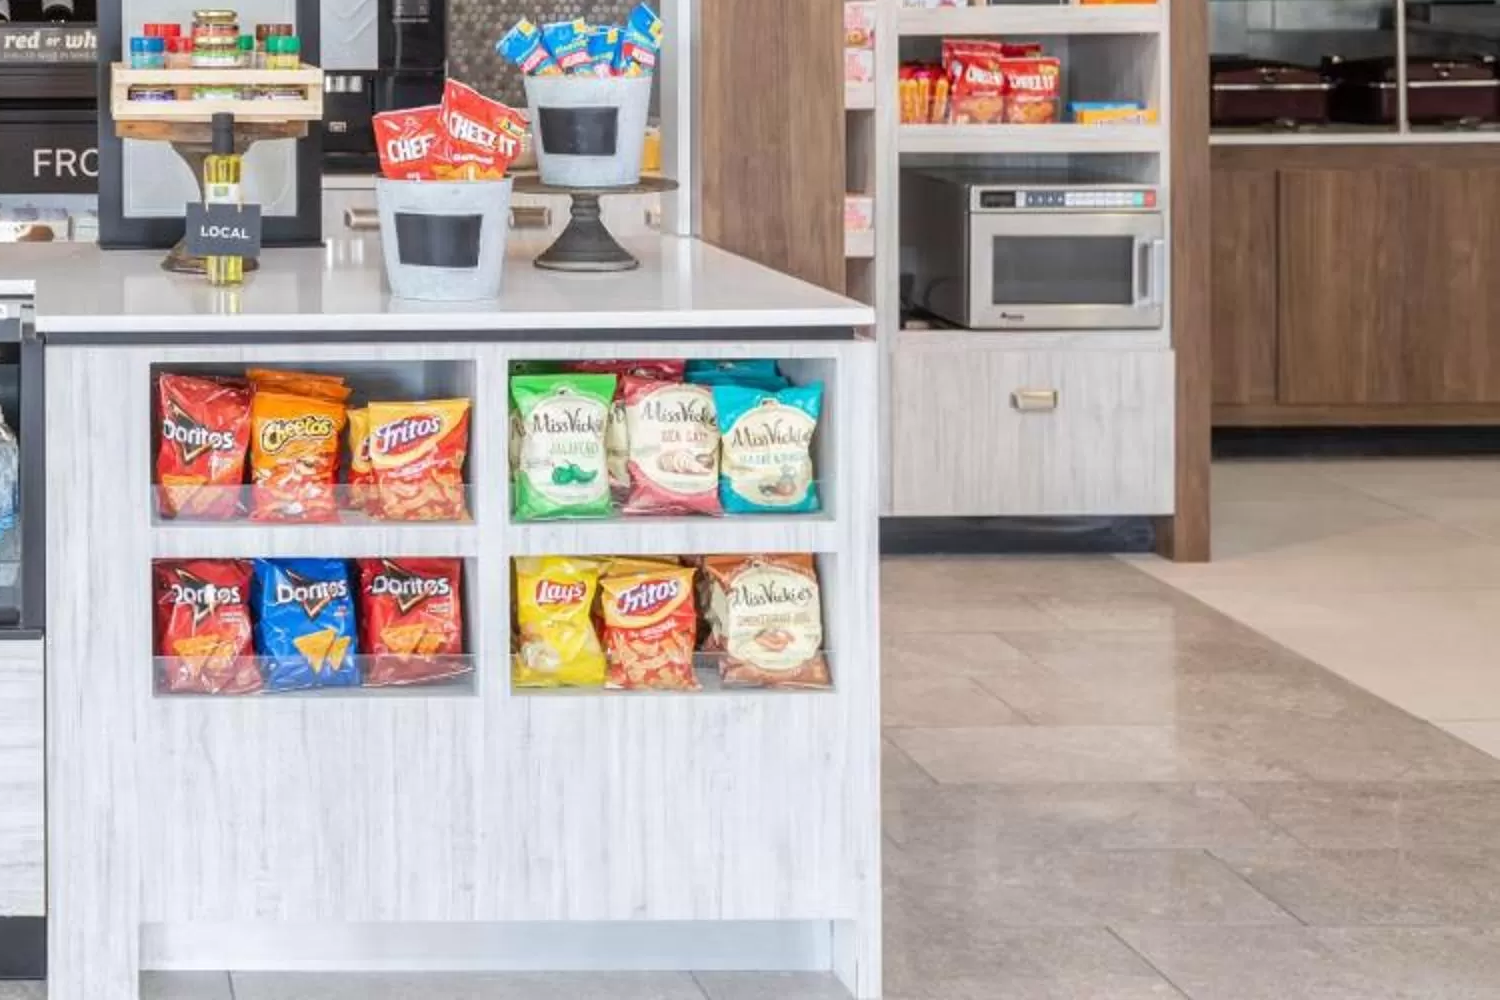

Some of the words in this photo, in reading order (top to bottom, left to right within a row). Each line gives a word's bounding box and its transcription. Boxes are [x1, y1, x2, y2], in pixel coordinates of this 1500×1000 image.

[3, 30, 40, 49] red
[64, 29, 98, 50] wh
[32, 149, 98, 177] FRO
[200, 224, 250, 240] LOCAL
[162, 418, 234, 449] Doritos
[262, 415, 333, 452] Cheetos
[375, 416, 441, 453] Fritos
[170, 583, 241, 604] Doritos
[276, 579, 348, 604] Doritos
[371, 575, 449, 596] Doritos
[614, 579, 678, 613] Fritos
